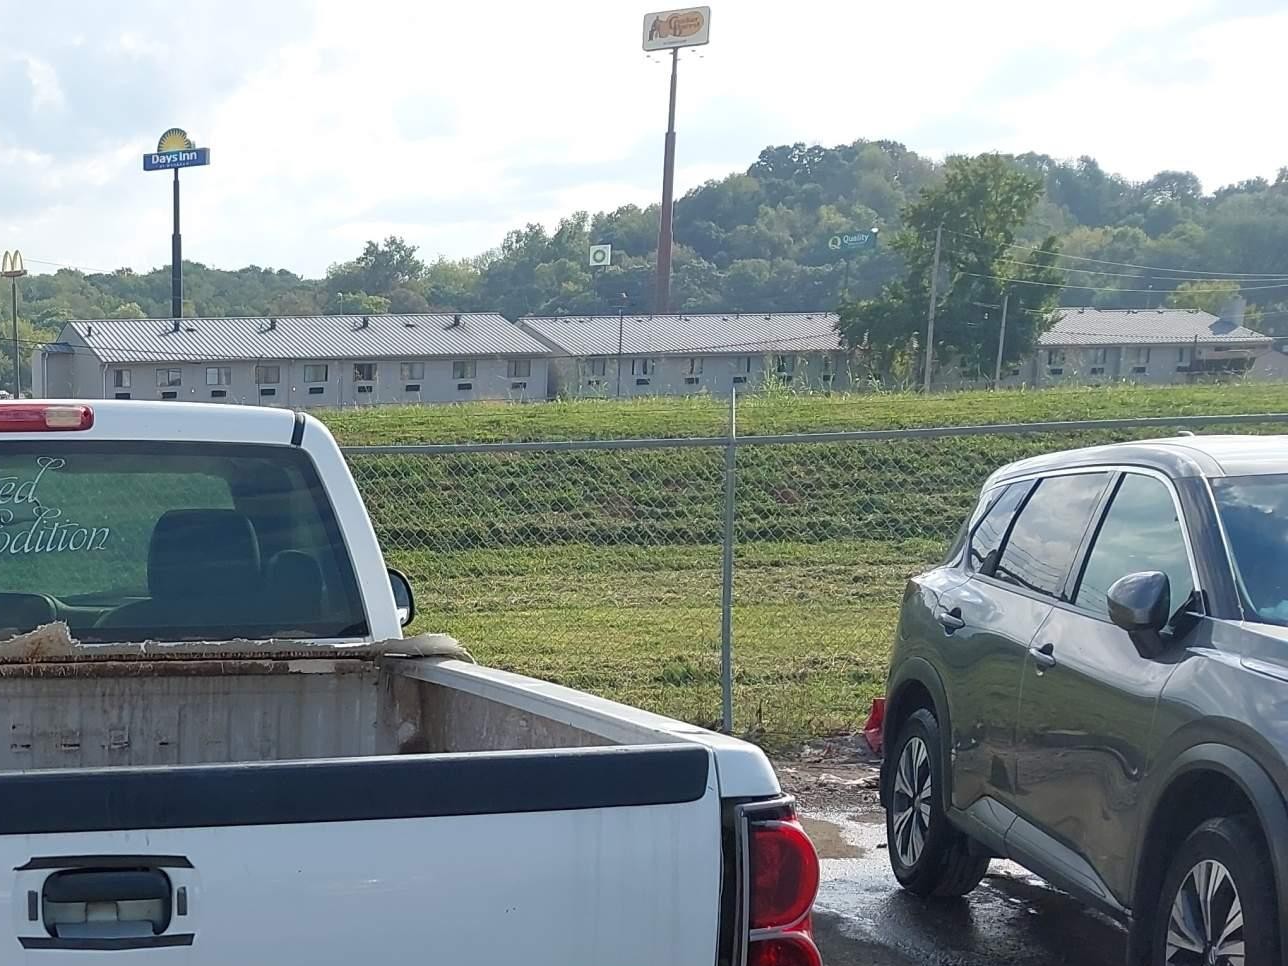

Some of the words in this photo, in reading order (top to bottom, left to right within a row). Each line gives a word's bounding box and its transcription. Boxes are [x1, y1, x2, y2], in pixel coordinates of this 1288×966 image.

[151, 153, 177, 164] Days
[179, 151, 198, 161] Inn
[843, 234, 870, 244] Quality
